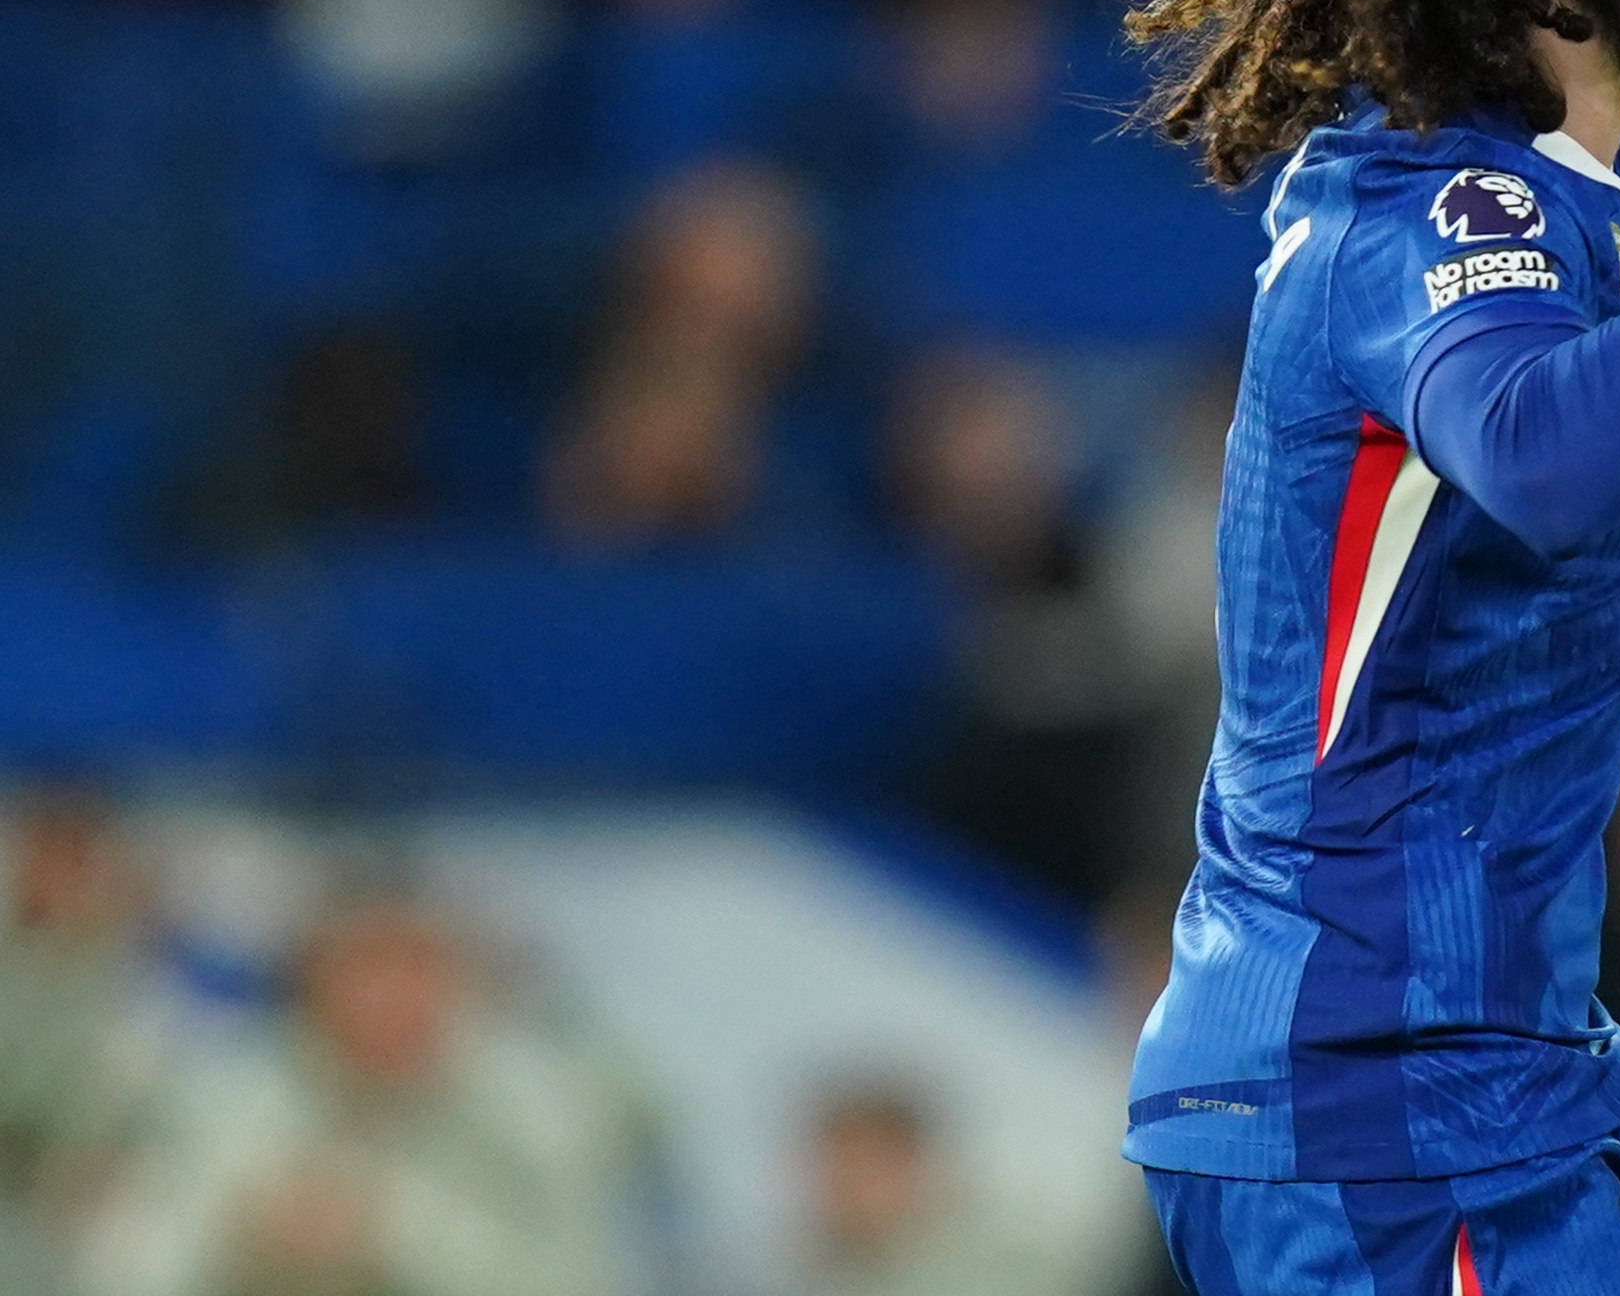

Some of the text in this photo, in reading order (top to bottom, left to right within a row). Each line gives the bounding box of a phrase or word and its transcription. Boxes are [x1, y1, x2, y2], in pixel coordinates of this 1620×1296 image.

[1424, 250, 1546, 288] No room
[1465, 269, 1559, 294] racism
